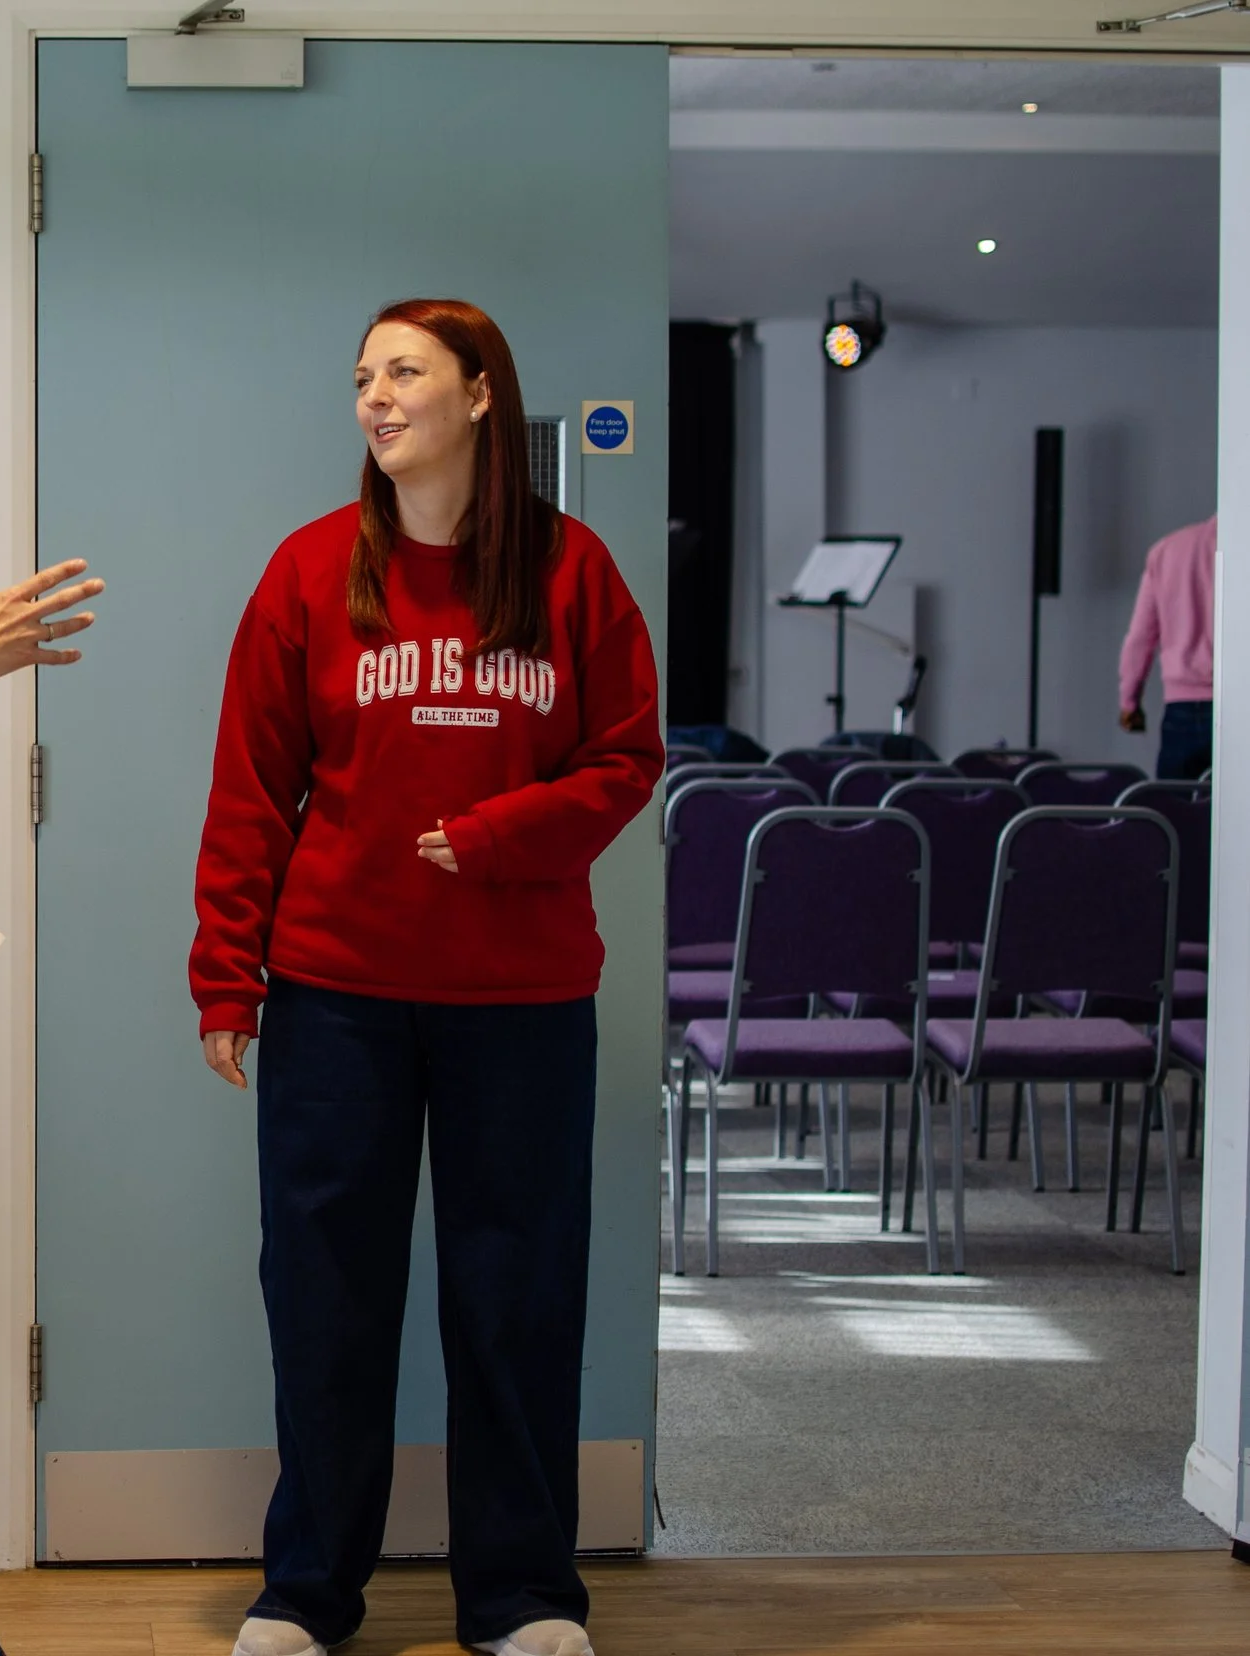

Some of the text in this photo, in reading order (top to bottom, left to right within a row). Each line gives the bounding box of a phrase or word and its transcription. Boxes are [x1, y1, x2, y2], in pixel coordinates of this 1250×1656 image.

[591, 418, 624, 426] Fire door
[589, 428, 625, 436] keep shut
[356, 637, 556, 716] GOD IS GOOD
[416, 710, 494, 723] ALL THE TIME
